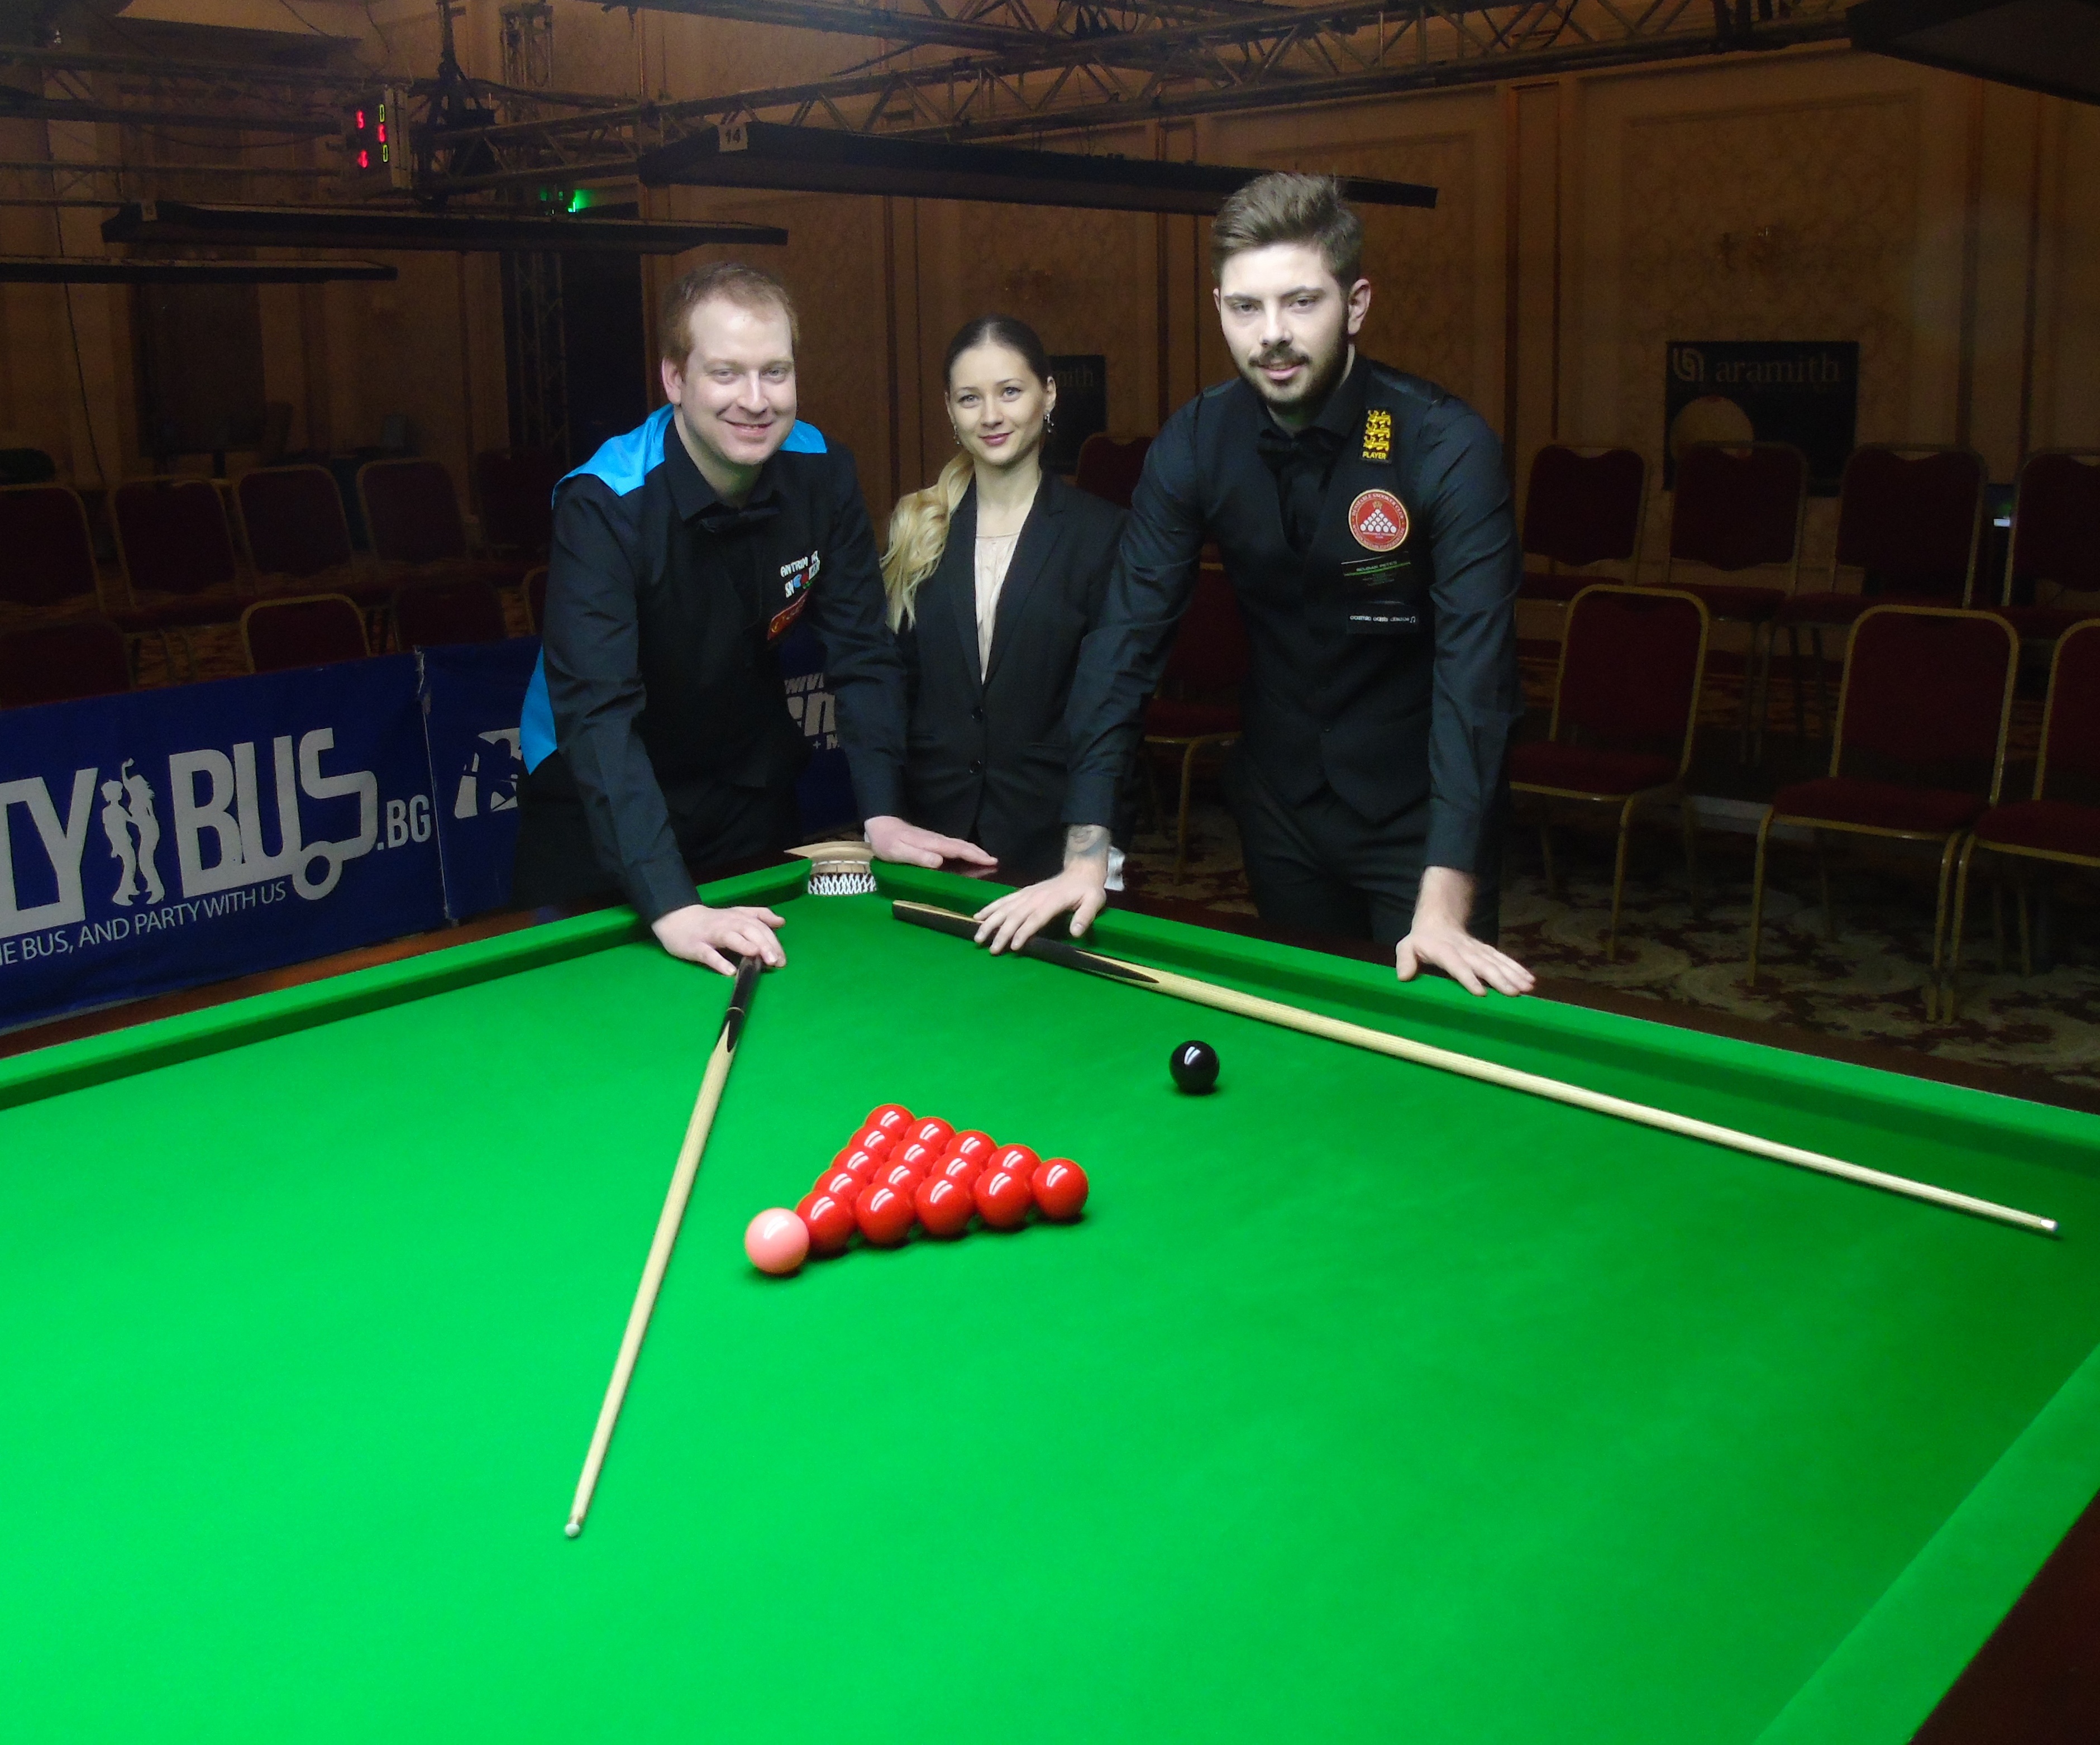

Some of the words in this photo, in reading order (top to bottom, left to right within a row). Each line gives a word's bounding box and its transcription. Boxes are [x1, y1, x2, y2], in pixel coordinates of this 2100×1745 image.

[725, 128, 741, 144] 14
[1715, 352, 1841, 383] aramith
[1362, 451, 1386, 460] PLAYER
[1372, 493, 1396, 507] SNOOKER
[1395, 505, 1405, 519] CLUB
[780, 556, 808, 578] ANTRIM
[0, 942, 17, 966] E
[22, 930, 74, 960] BUS,
[79, 917, 130, 947] AND
[135, 903, 202, 936] PARTY
[202, 889, 256, 921] WITH
[261, 881, 287, 905] US
